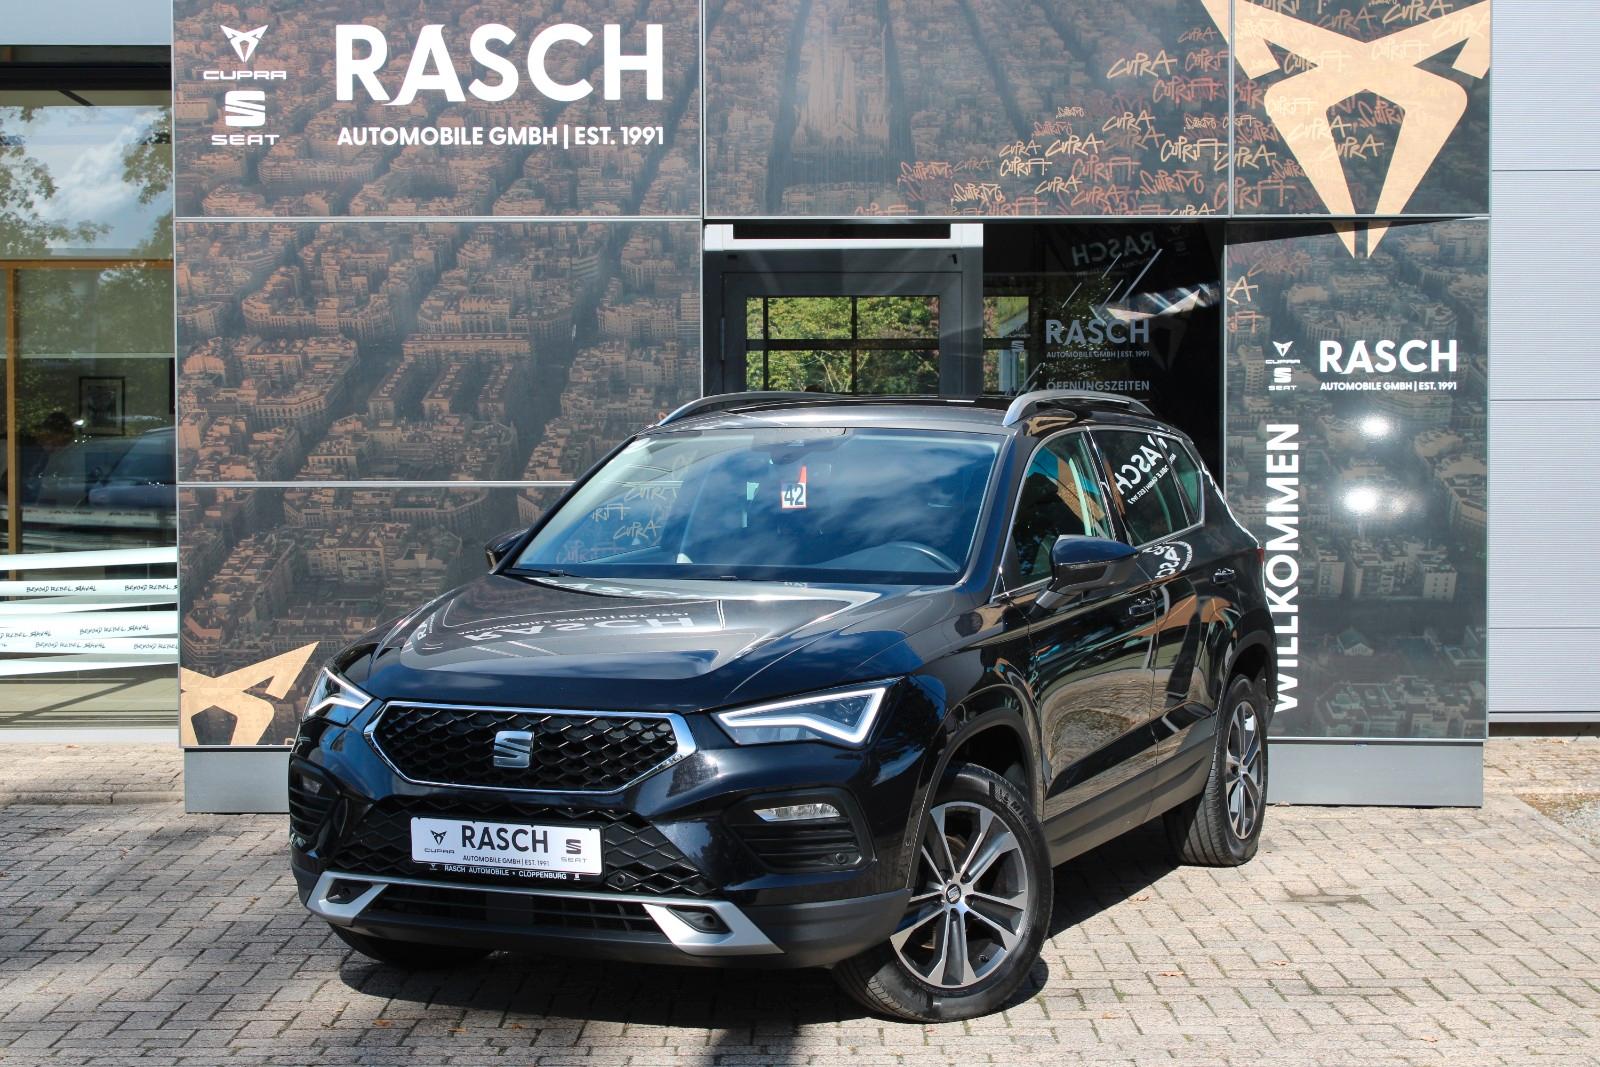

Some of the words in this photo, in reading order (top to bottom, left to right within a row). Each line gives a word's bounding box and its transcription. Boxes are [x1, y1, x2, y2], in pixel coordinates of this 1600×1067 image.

[336, 24, 663, 105] RASCH
[1107, 49, 1178, 79] CUPRA
[204, 71, 286, 80] CUPRA
[1102, 110, 1156, 132] CUPRA
[212, 134, 279, 145] SEAT
[337, 126, 483, 147] AUTOMOBILE
[489, 126, 557, 147] GMBH
[575, 126, 615, 147] EST.
[621, 126, 663, 147] 1991
[1045, 132, 1104, 157] CUPRA
[1046, 319, 1149, 345] RASCH
[1320, 340, 1457, 374] RASCH
[1320, 381, 1381, 391] AUTOMOBILE
[1383, 381, 1412, 391] GMBH
[1419, 381, 1436, 391] EST.
[1438, 381, 1457, 391] 1991
[784, 485, 804, 506] 42
[1266, 424, 1299, 712] WILLKOMMEN
[461, 825, 548, 853] RASCH
[444, 864, 466, 873] RASCH
[469, 866, 509, 876] AUTOMOBILE
[518, 870, 567, 880] CLOPPENBURG
[463, 855, 501, 864] AUTOMOBILE
[503, 857, 521, 865] GMBH
[537, 859, 550, 867] 1991
